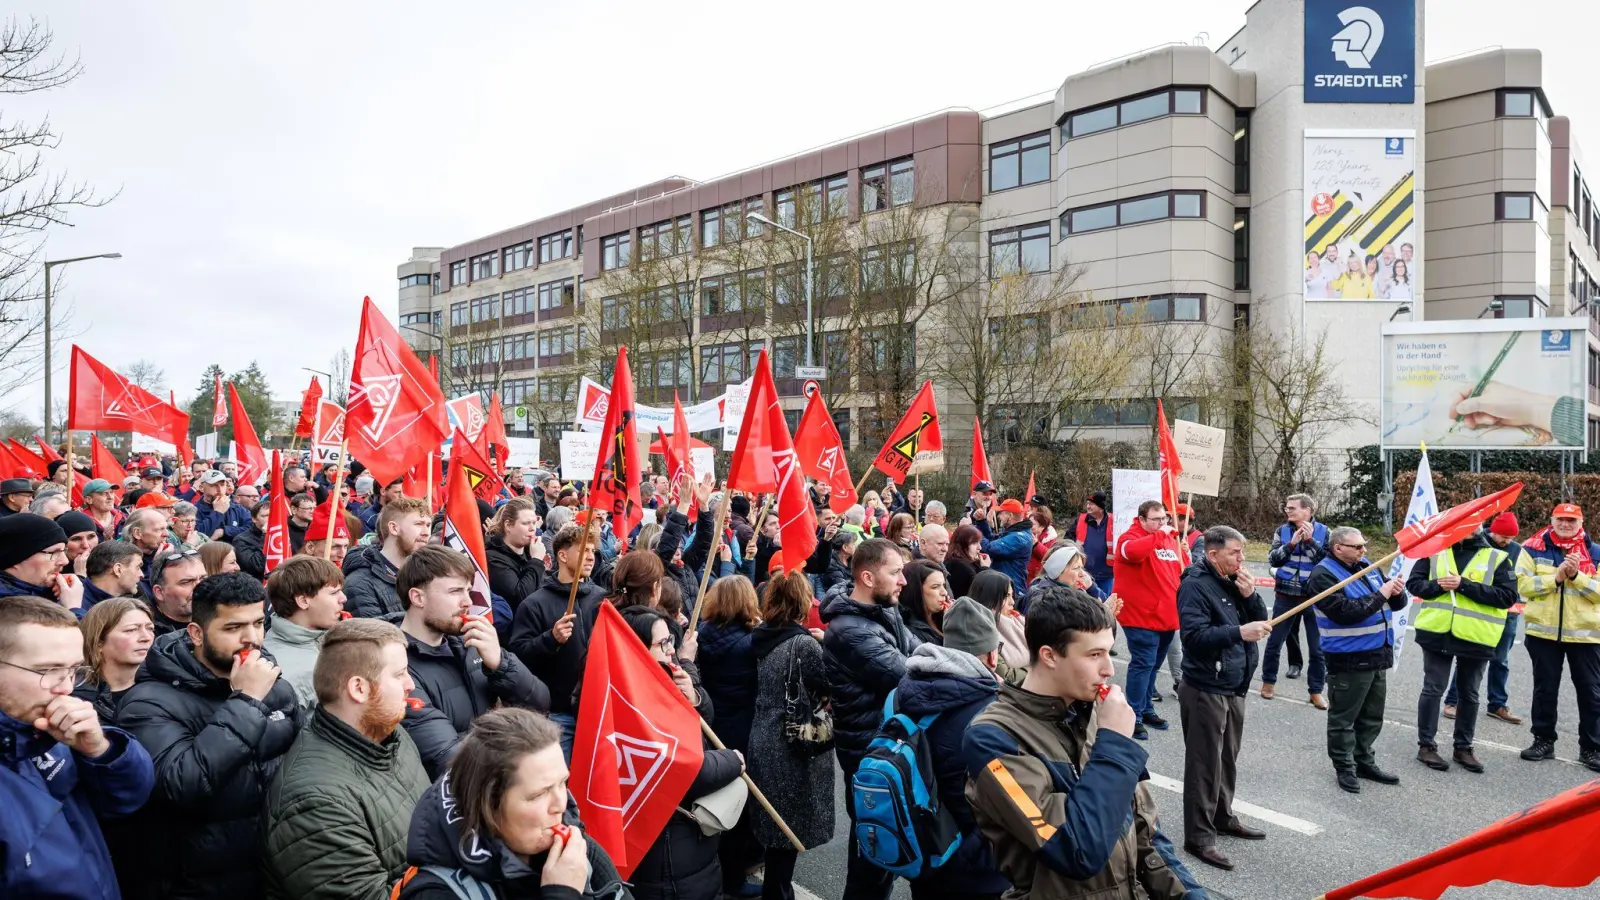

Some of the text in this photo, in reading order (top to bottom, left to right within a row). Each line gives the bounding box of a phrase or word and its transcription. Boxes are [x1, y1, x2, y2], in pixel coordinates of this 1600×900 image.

[1314, 74, 1403, 88] STAEDTLER
[1313, 159, 1371, 173] 125 Years
